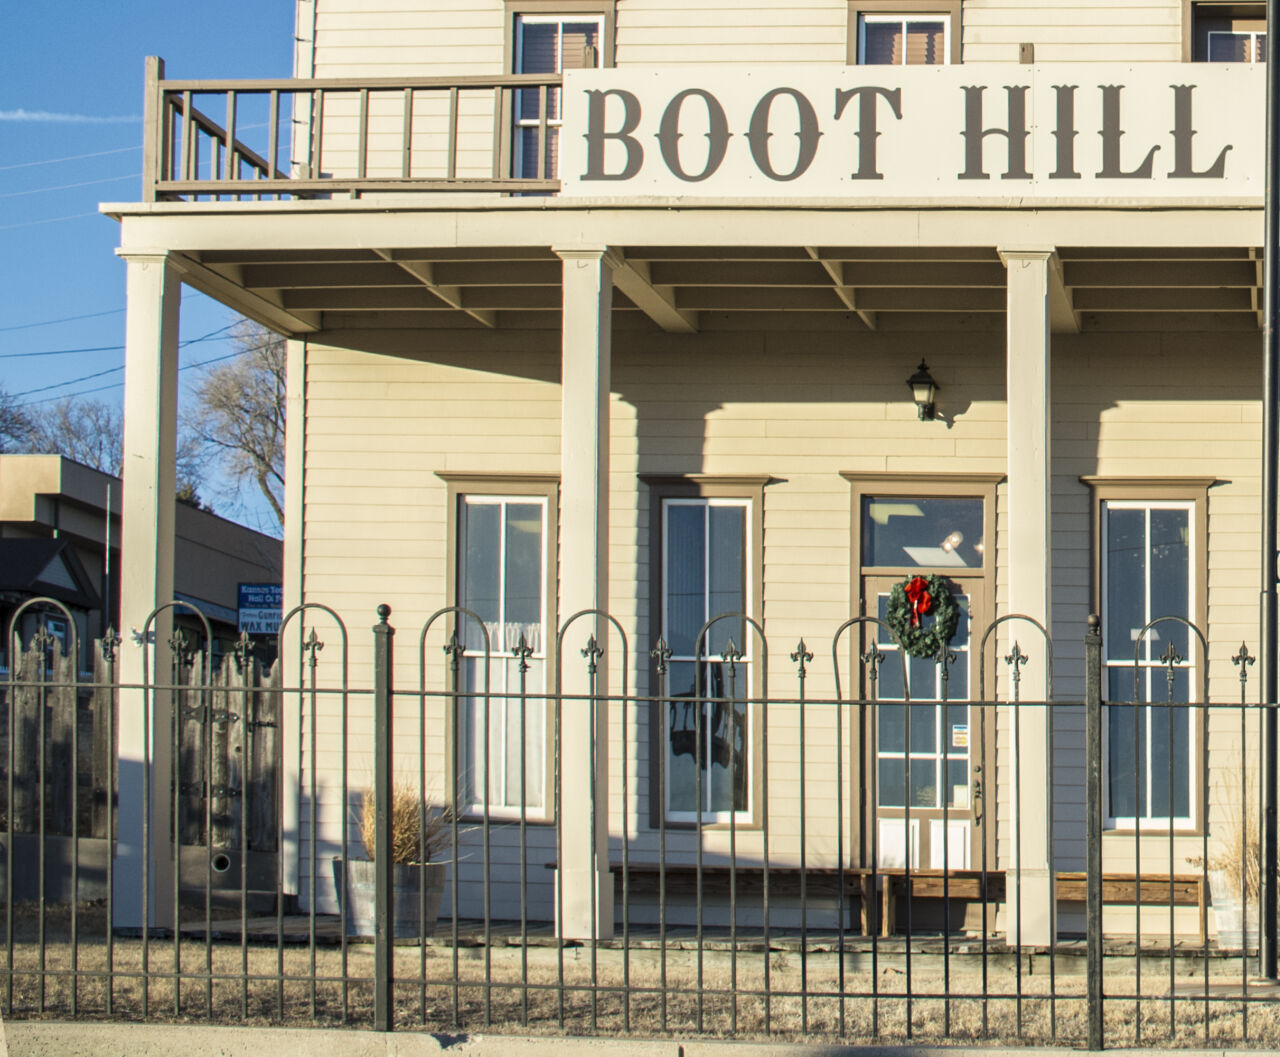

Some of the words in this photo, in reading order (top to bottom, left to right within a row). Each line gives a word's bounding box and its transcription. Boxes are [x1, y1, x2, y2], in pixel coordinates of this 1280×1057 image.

[579, 86, 903, 182] BOOT
[957, 84, 1233, 180] HILL
[240, 621, 263, 632] WAX
